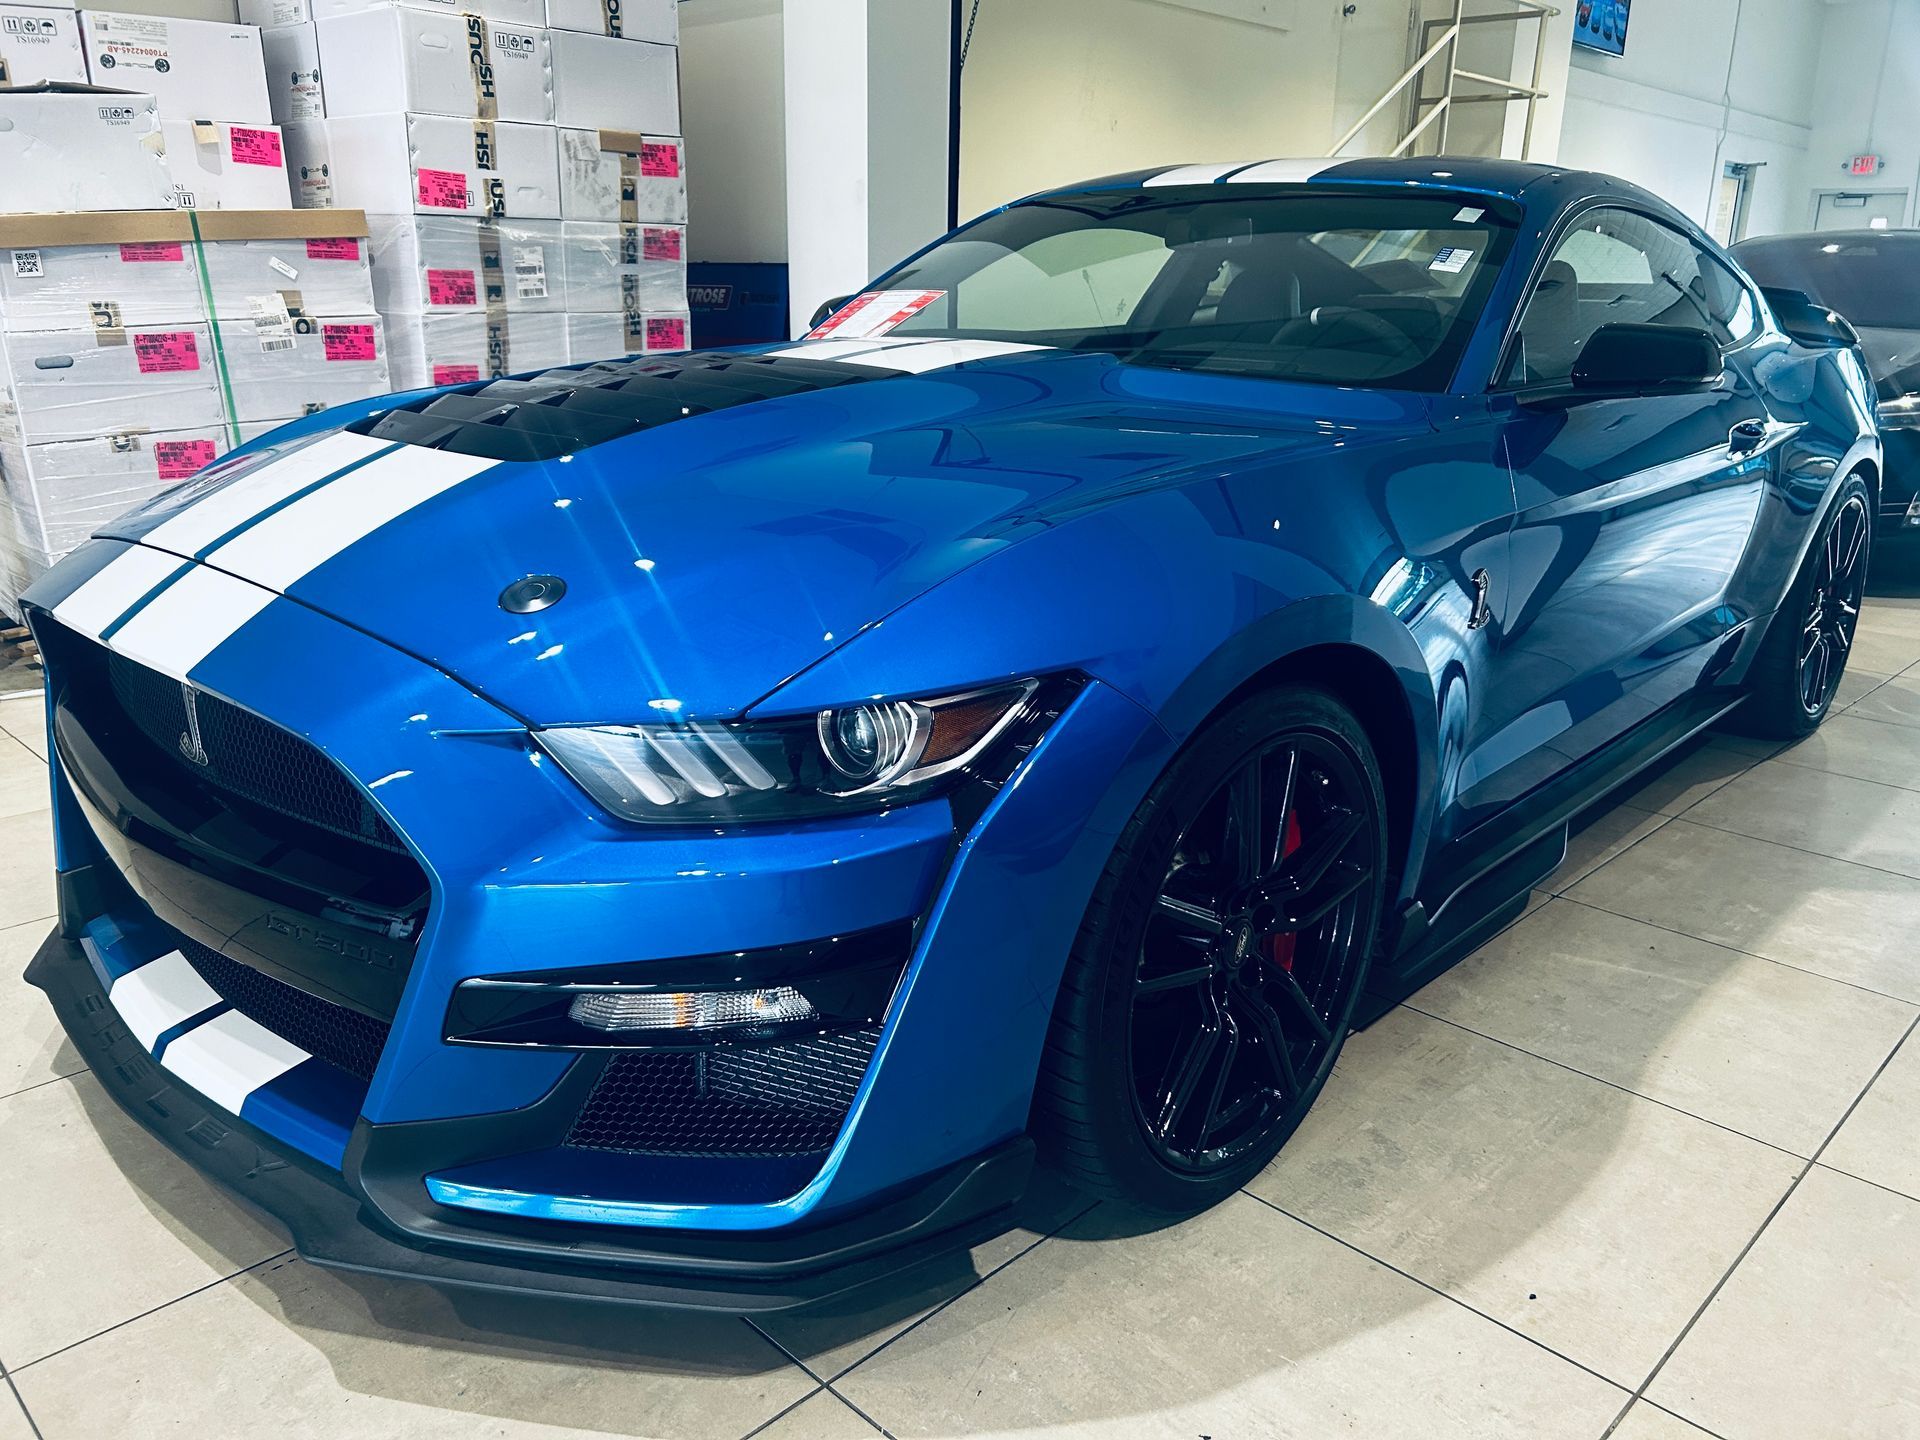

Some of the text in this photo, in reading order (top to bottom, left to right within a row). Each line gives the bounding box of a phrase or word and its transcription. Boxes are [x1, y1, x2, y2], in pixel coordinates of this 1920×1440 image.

[16, 35, 50, 44] TS16949
[107, 45, 168, 57] PT00042245-AB
[503, 50, 529, 60] TS16949
[1853, 157, 1875, 173] EXIT
[687, 288, 726, 304] TROSE
[266, 913, 397, 972] GT500
